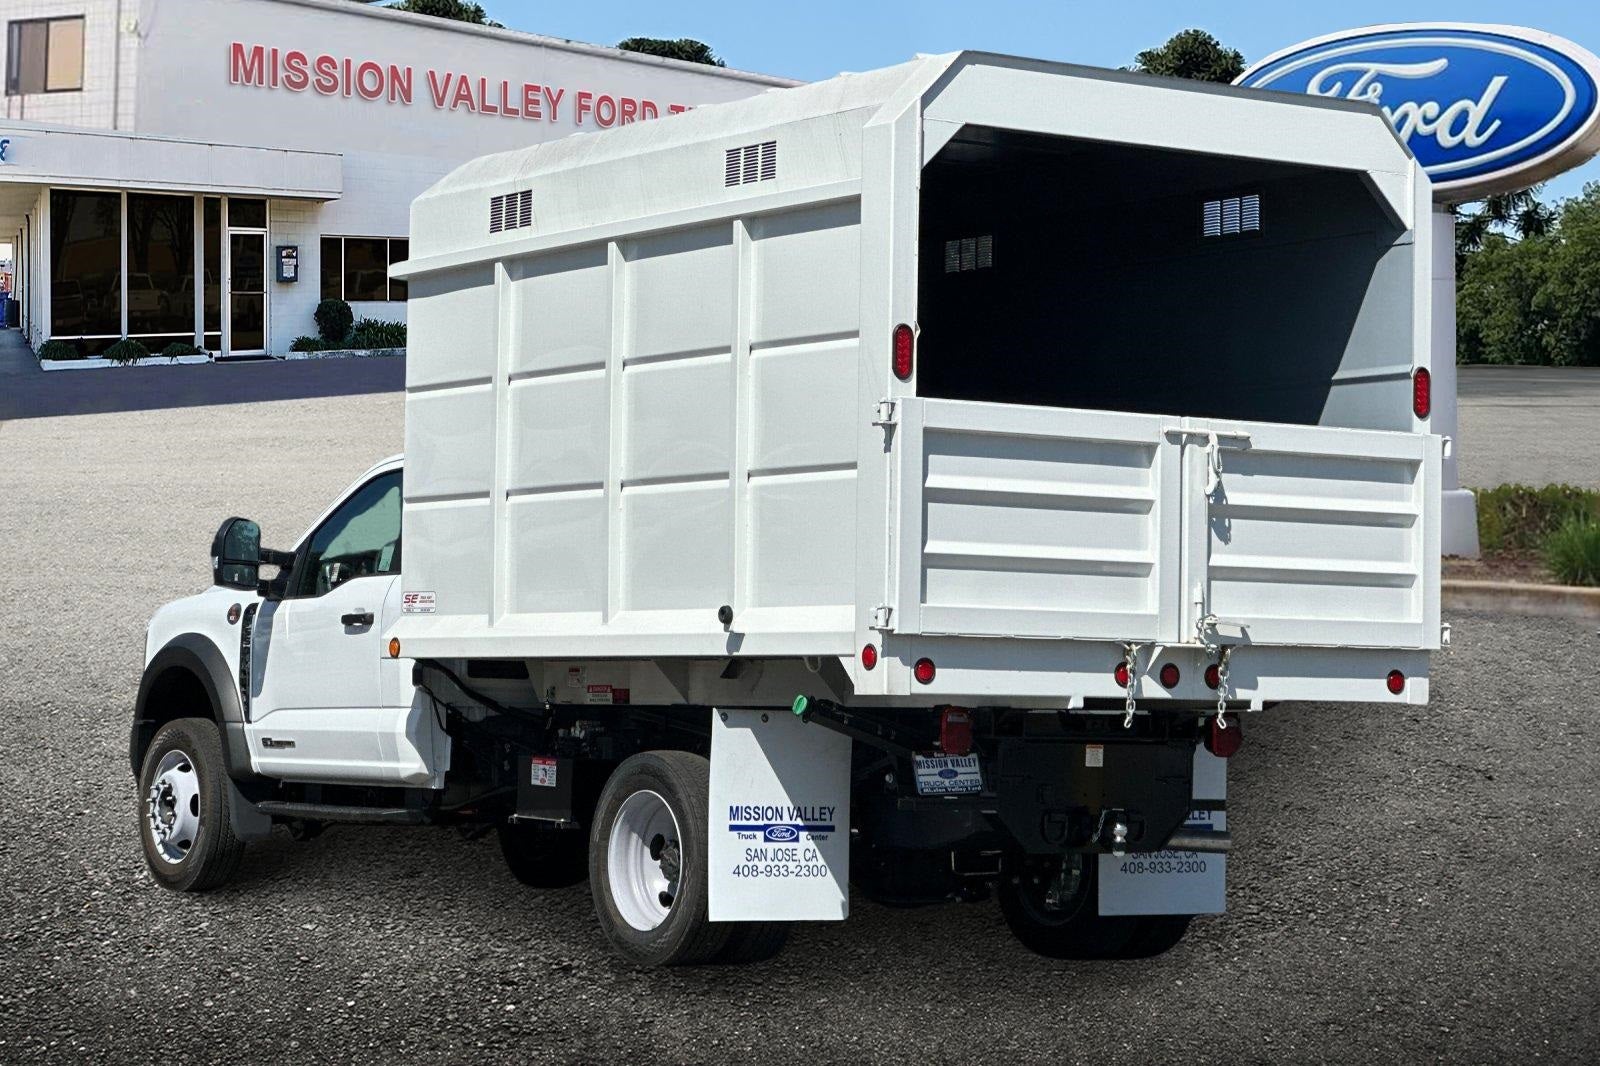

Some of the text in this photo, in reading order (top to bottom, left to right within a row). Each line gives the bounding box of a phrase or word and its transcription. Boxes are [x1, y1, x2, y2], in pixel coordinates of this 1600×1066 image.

[230, 41, 659, 129] MISSION VALLEY FORD
[1306, 57, 1508, 149] Frd
[917, 757, 977, 769] MISSION VALLEY
[729, 806, 836, 822] MISSION VALLEY
[737, 827, 828, 841] Truck Ford Center
[745, 848, 819, 863] SAN JOSE, CA
[732, 864, 828, 878] 408-933-2300
[1120, 860, 1207, 874] 408-933-2300
